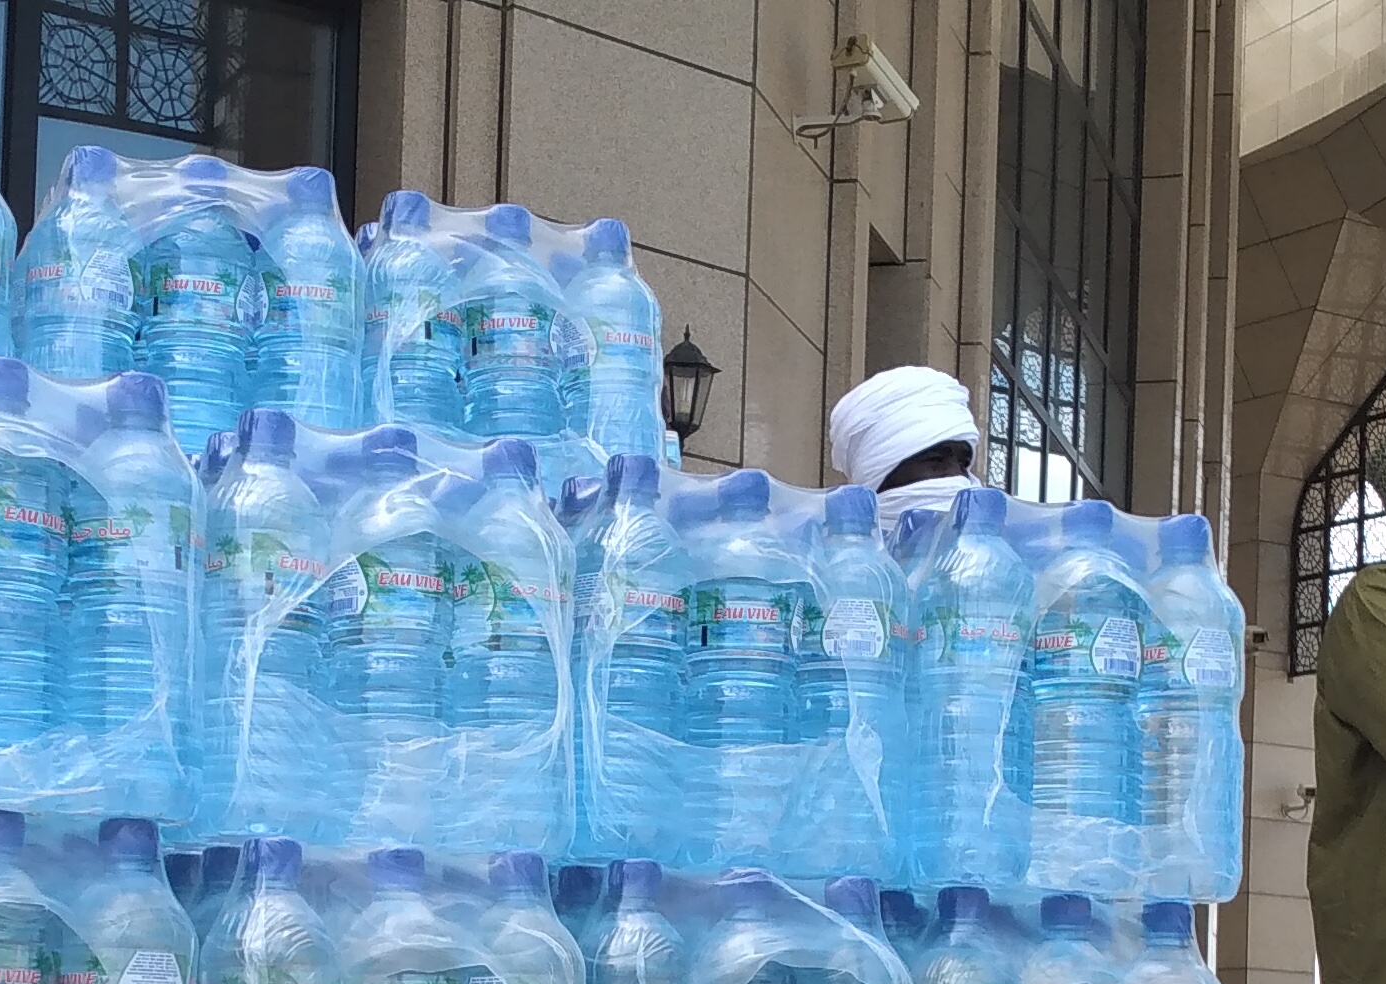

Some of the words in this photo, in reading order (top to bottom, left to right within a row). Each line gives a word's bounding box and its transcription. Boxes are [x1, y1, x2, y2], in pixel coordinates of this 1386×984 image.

[163, 279, 189, 292] EAU
[193, 281, 223, 294] VIVE
[275, 286, 301, 298] EAU
[304, 286, 334, 299] VIVE
[481, 318, 504, 331] EAU
[507, 317, 537, 329] VIVE
[605, 331, 630, 343] EAU
[5, 506, 38, 523] EAU
[279, 556, 309, 571] EAU
[378, 572, 411, 588] EAU
[415, 574, 443, 591] VIVE
[626, 591, 657, 606] EAU
[714, 607, 744, 620] EAU
[747, 607, 778, 622] VIVE
[992, 623, 1019, 640] مياه
[1045, 635, 1073, 648] VIVE
[1144, 648, 1165, 661] IVE
[5, 968, 41, 984] VIVE
